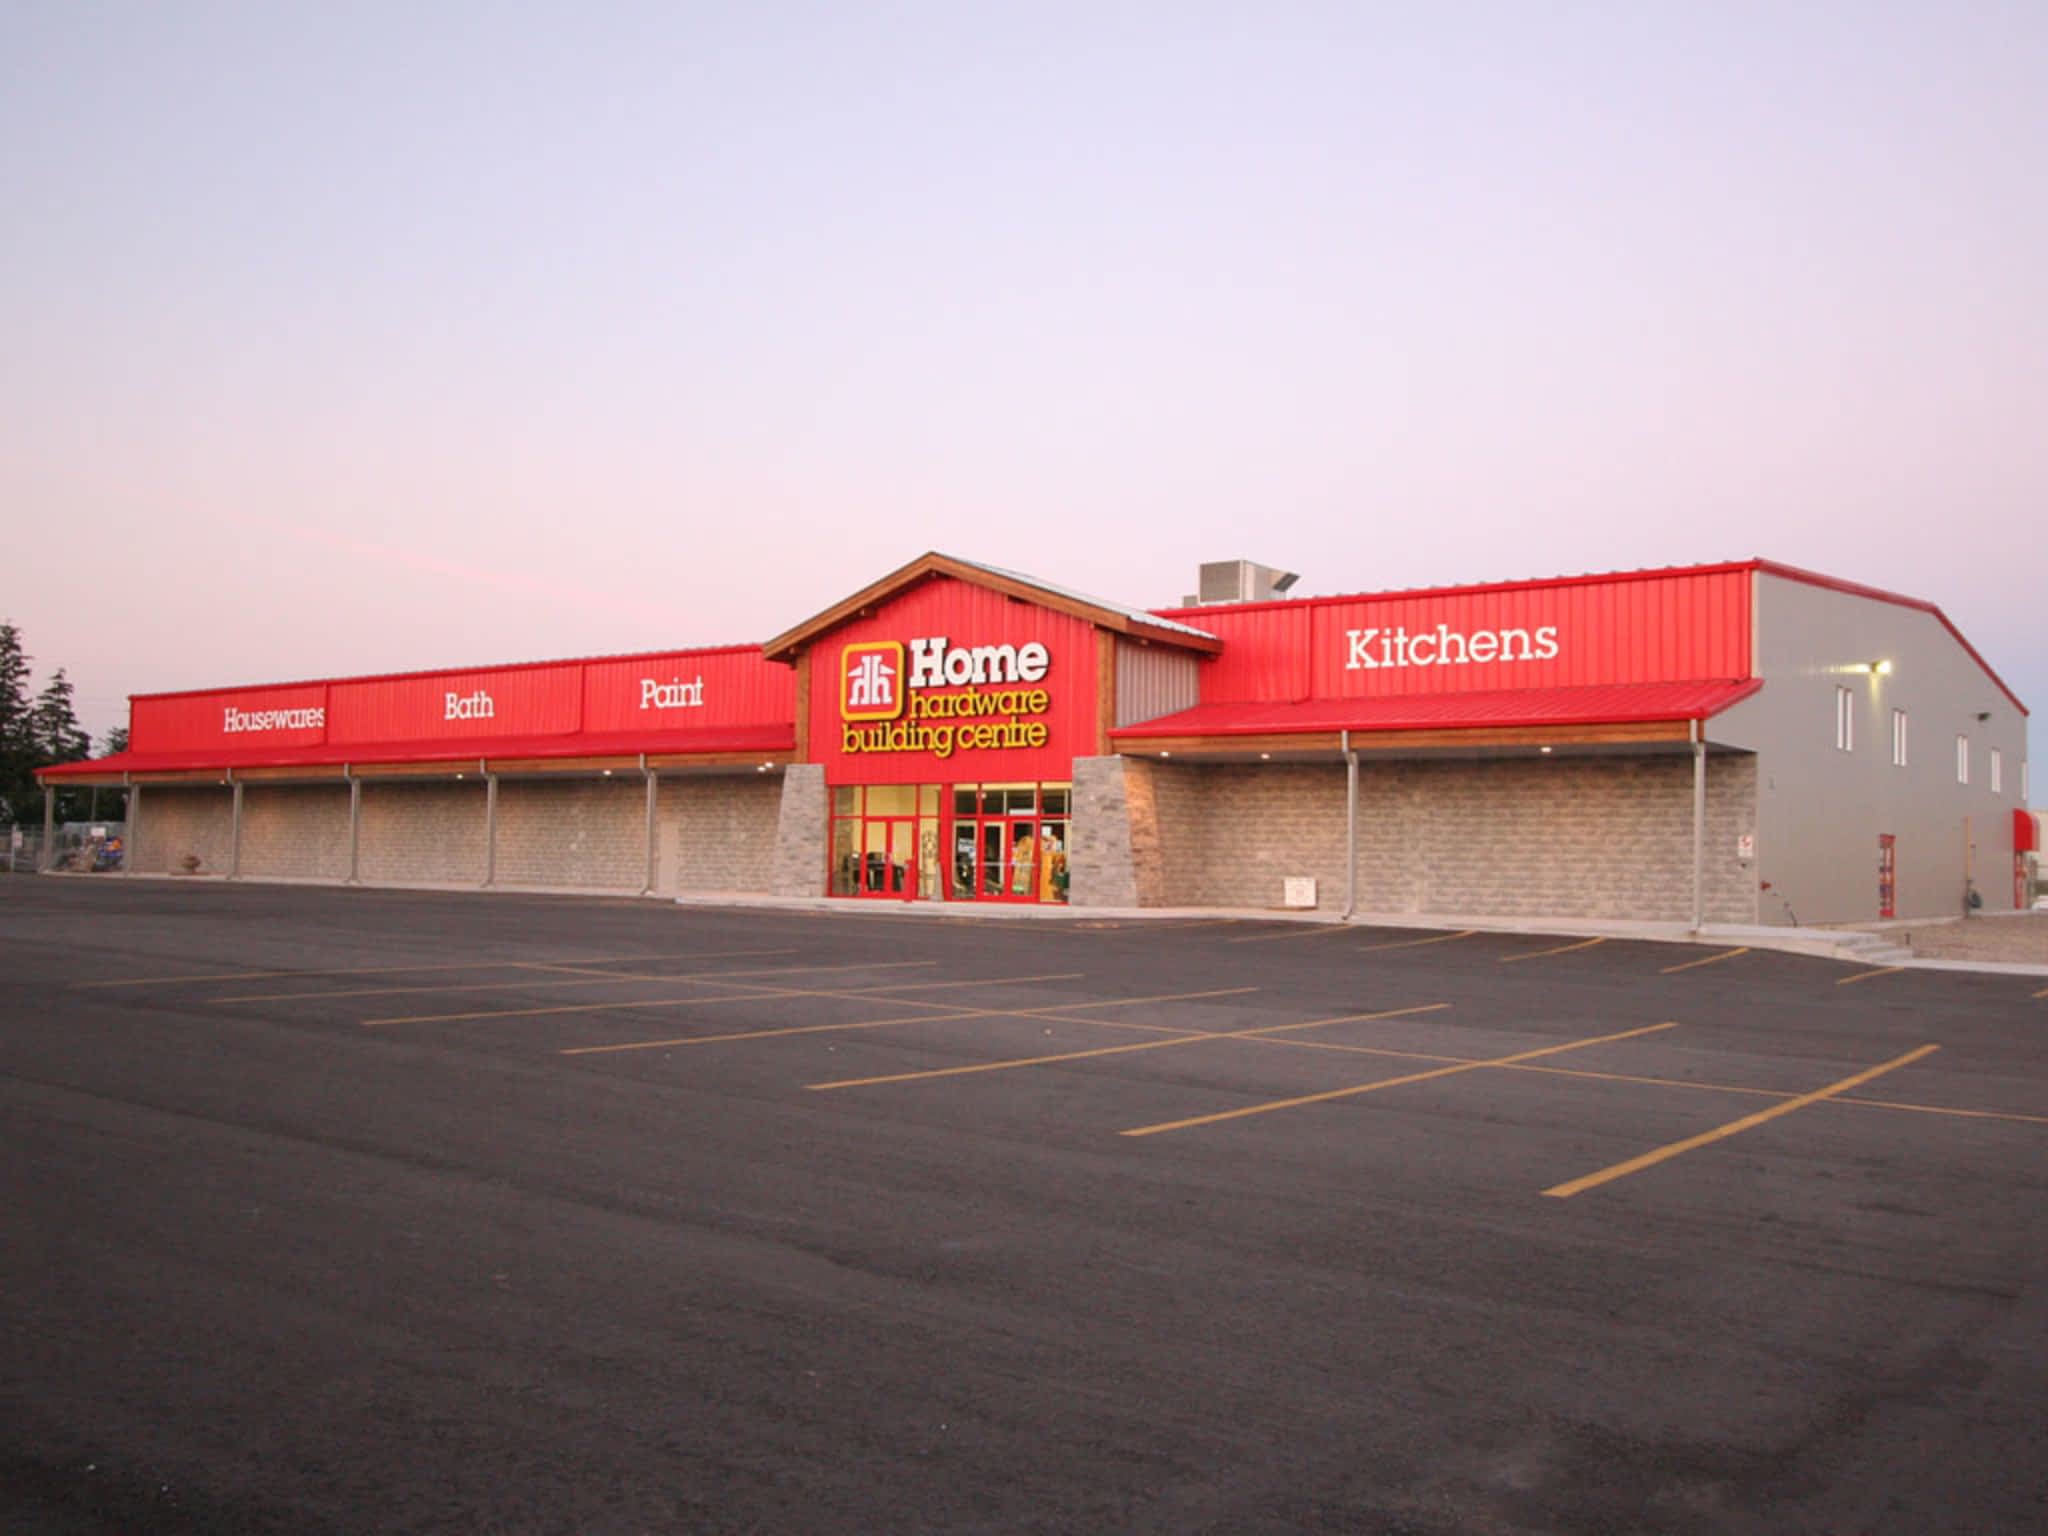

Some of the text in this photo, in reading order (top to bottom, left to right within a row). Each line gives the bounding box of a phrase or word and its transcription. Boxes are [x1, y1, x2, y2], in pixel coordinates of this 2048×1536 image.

[909, 636, 1049, 688] Home
[1344, 623, 1559, 670] Kitchens
[444, 690, 495, 721] Bath
[640, 675, 704, 710] Paint
[909, 686, 1048, 718] hardware
[223, 706, 325, 733] Housewares
[842, 716, 1047, 758] building centre
